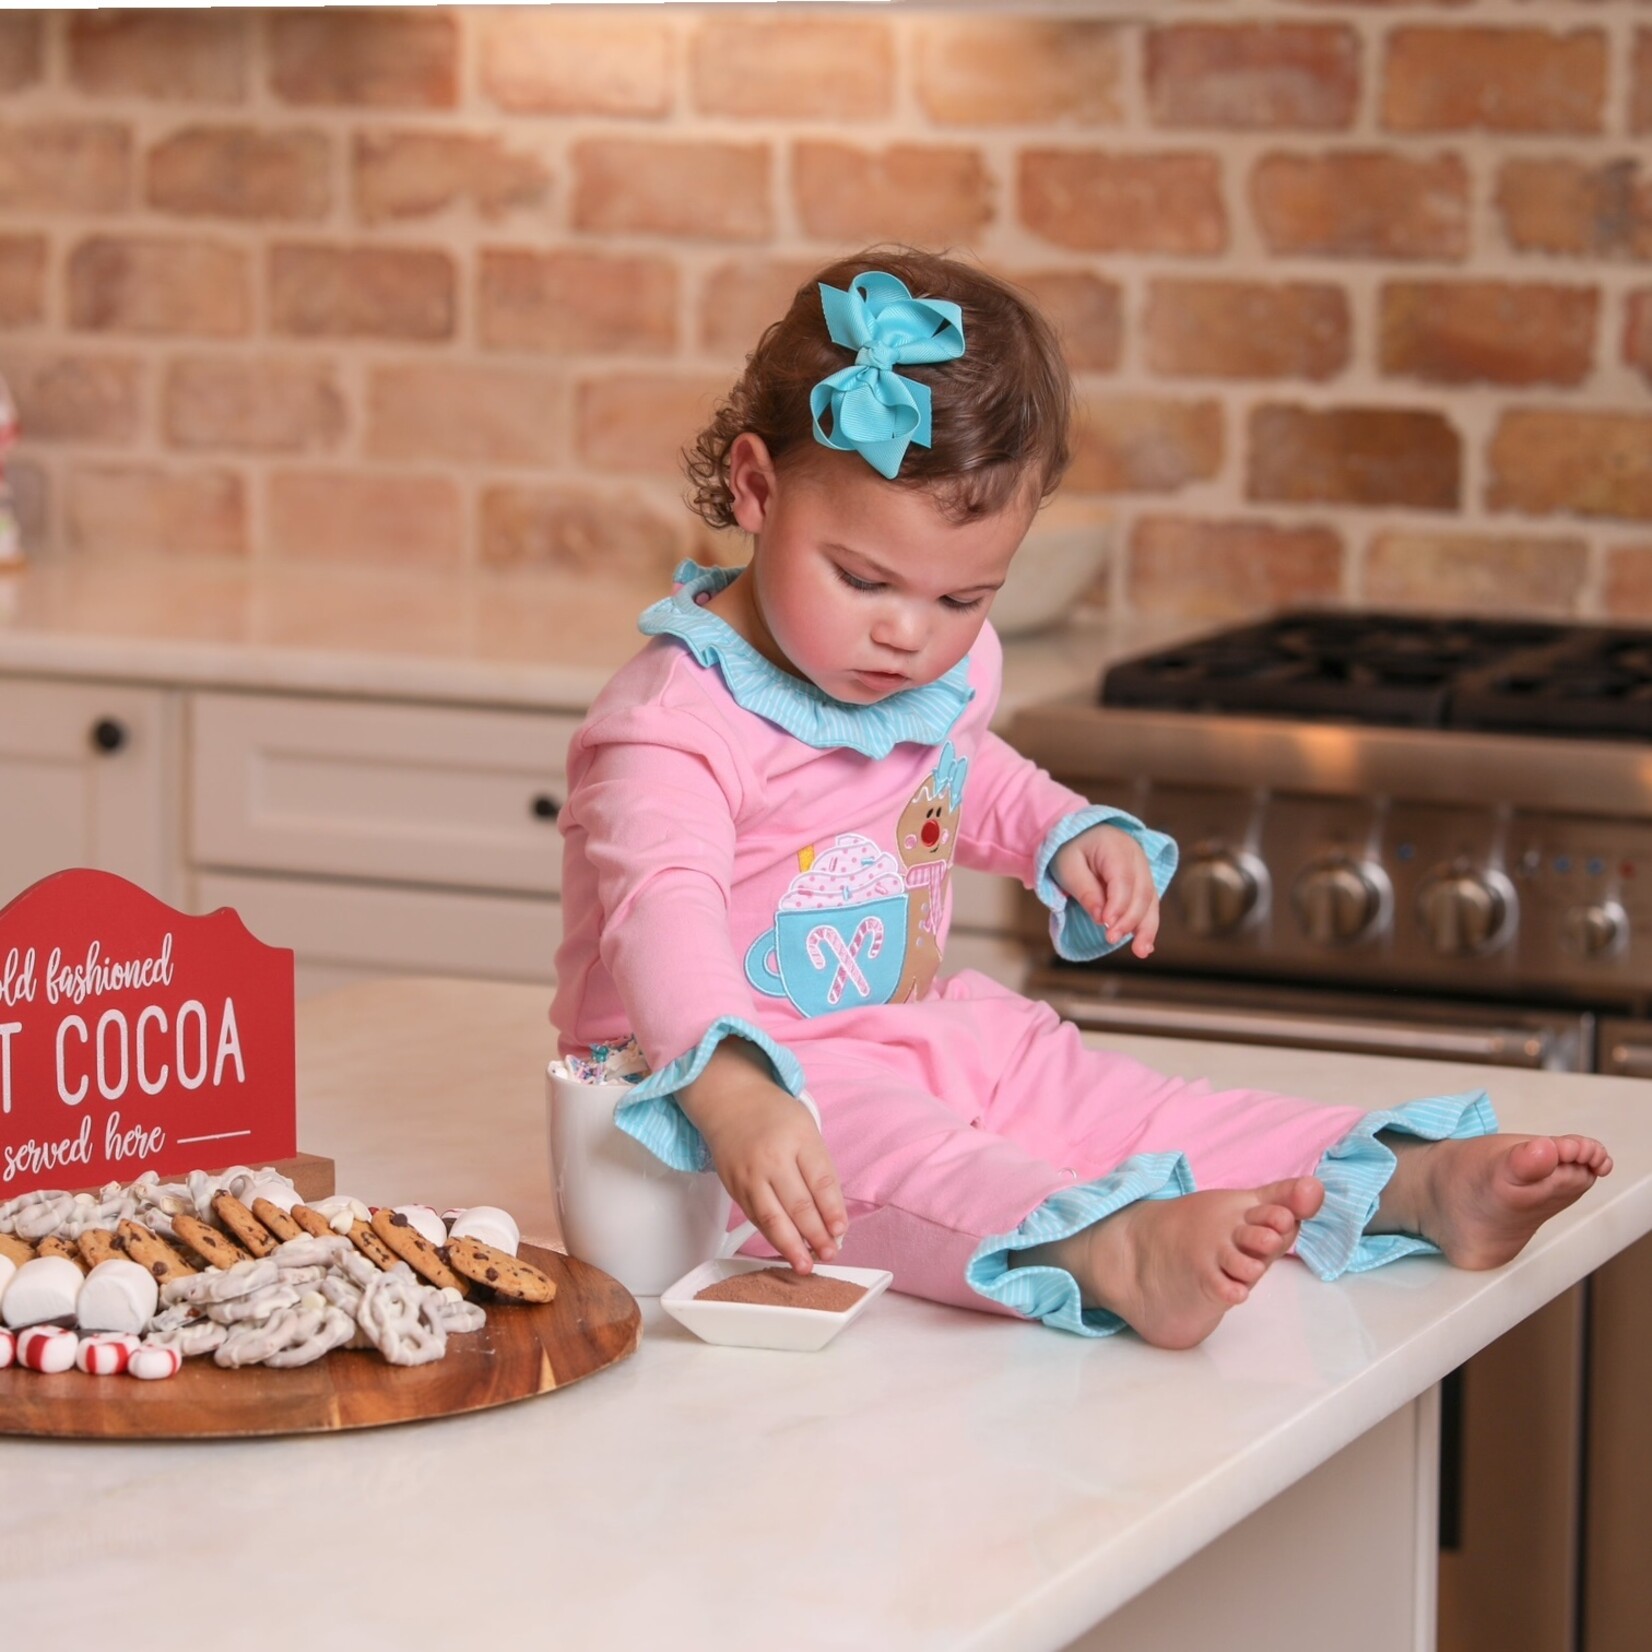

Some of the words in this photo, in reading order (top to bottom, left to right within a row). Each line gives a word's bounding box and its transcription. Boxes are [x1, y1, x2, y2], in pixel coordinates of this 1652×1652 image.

[0, 947, 37, 1007] ld
[46, 932, 174, 1005] fashioned
[56, 997, 246, 1106] COCOA
[2, 1115, 93, 1182] served
[105, 1111, 166, 1161] here
